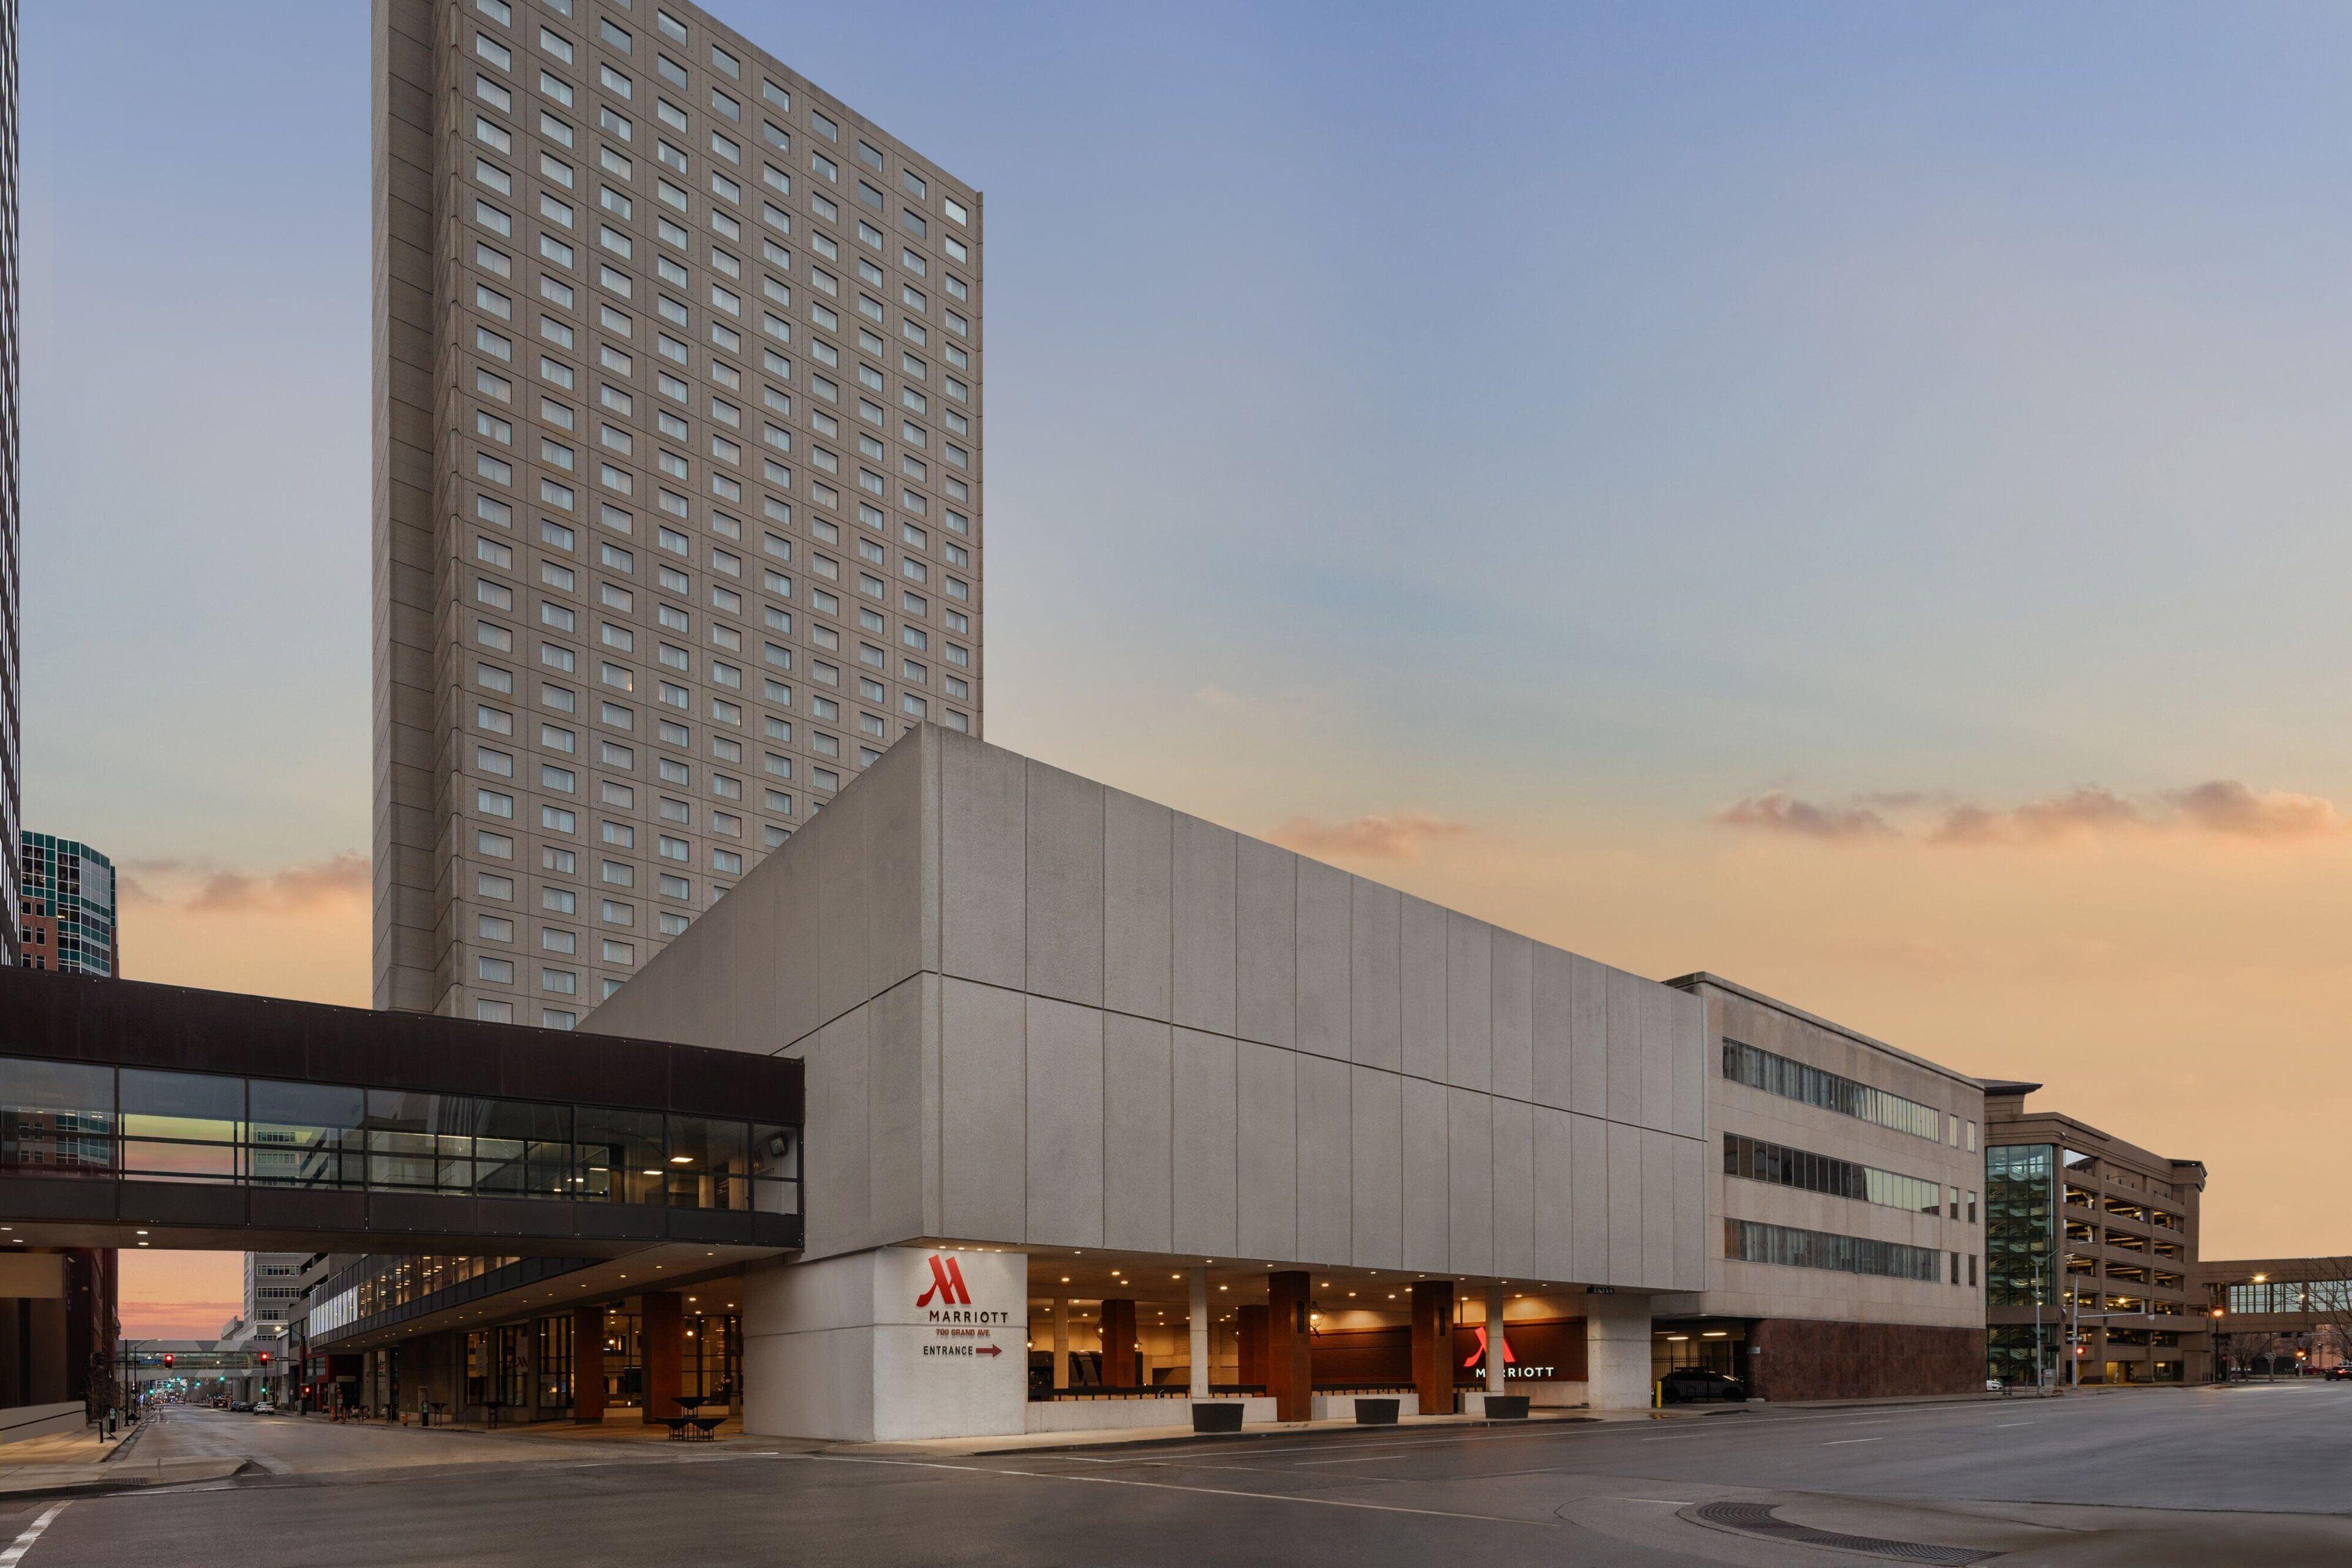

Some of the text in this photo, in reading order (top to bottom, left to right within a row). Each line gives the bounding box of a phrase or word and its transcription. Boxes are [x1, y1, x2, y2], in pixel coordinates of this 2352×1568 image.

[929, 1310, 1008, 1323] MARRIOTT
[923, 1346, 973, 1355] ENTRANCE
[1476, 1367, 1554, 1378] MRIOTT
